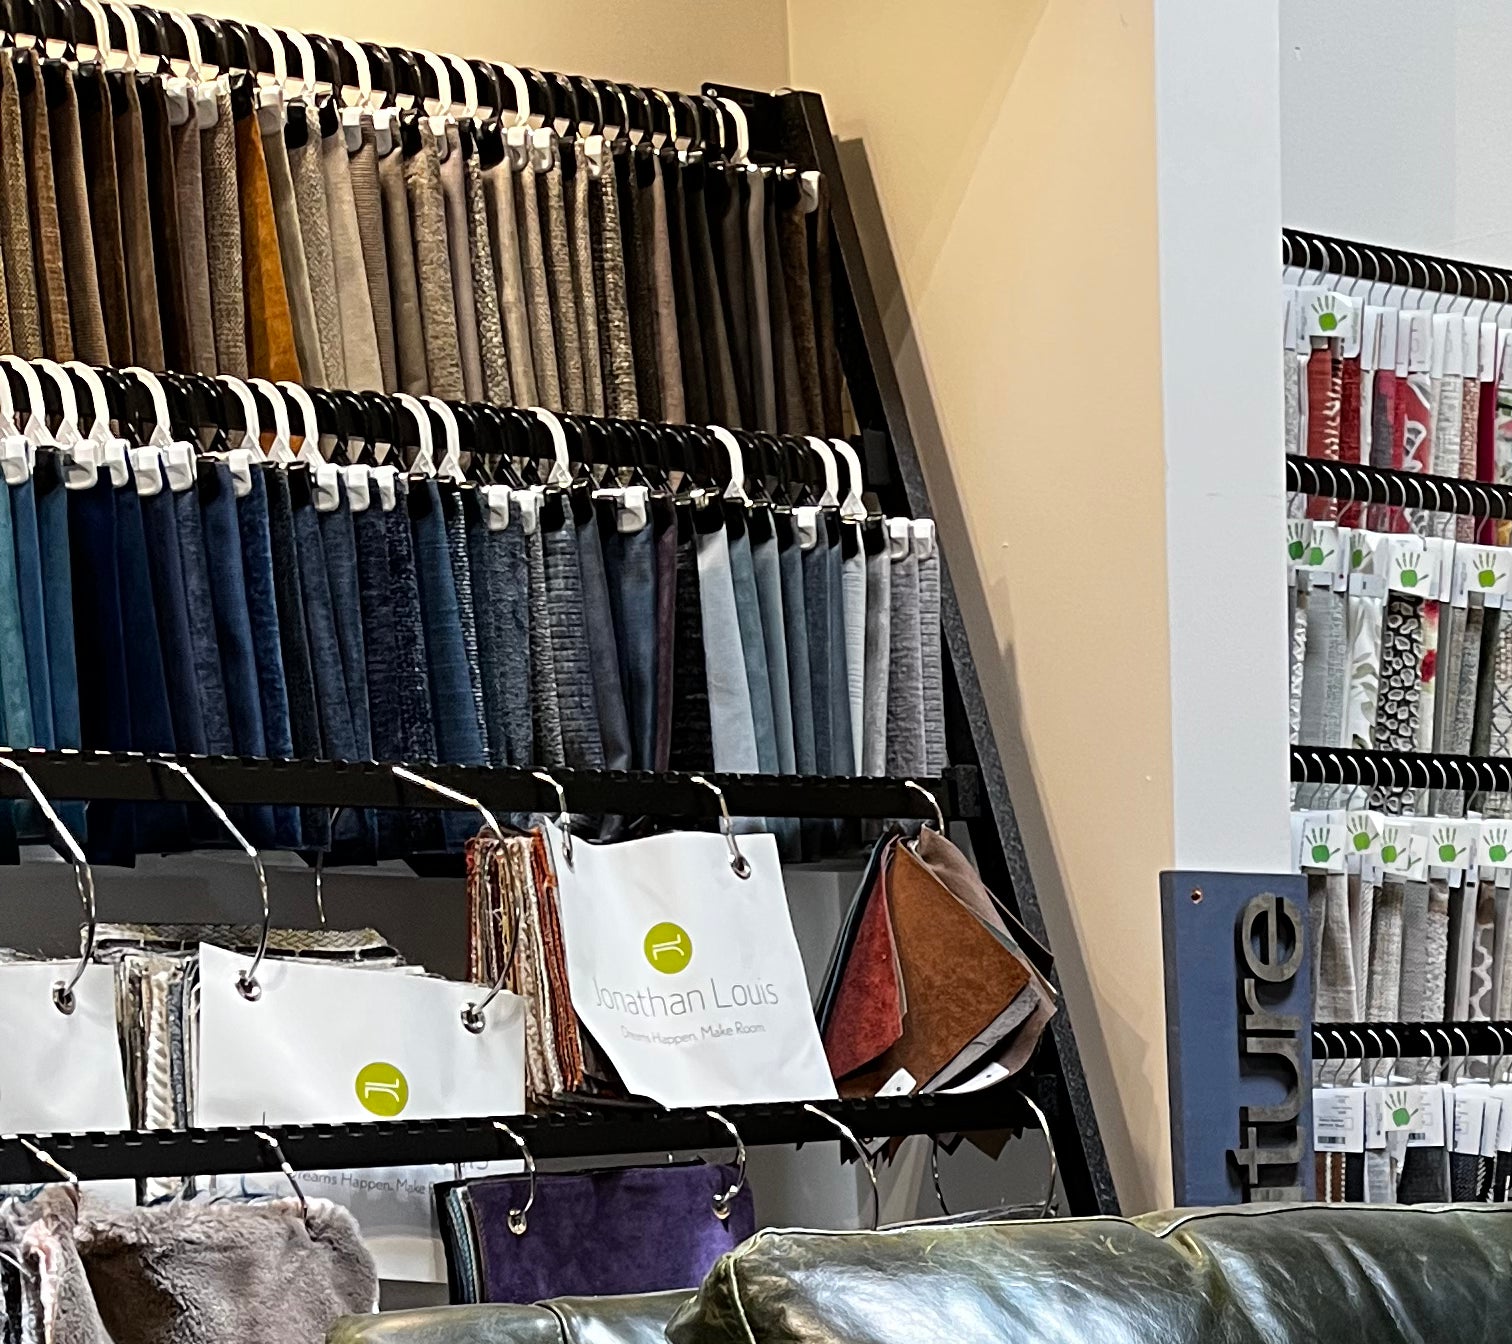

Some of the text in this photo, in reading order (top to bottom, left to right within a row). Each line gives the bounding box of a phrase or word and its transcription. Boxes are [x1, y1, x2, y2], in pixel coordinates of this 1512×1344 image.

[592, 975, 779, 1017] Jonathan Louis
[1232, 892, 1305, 1202] ture
[292, 1171, 338, 1186] reams
[396, 1178, 426, 1195] Make
